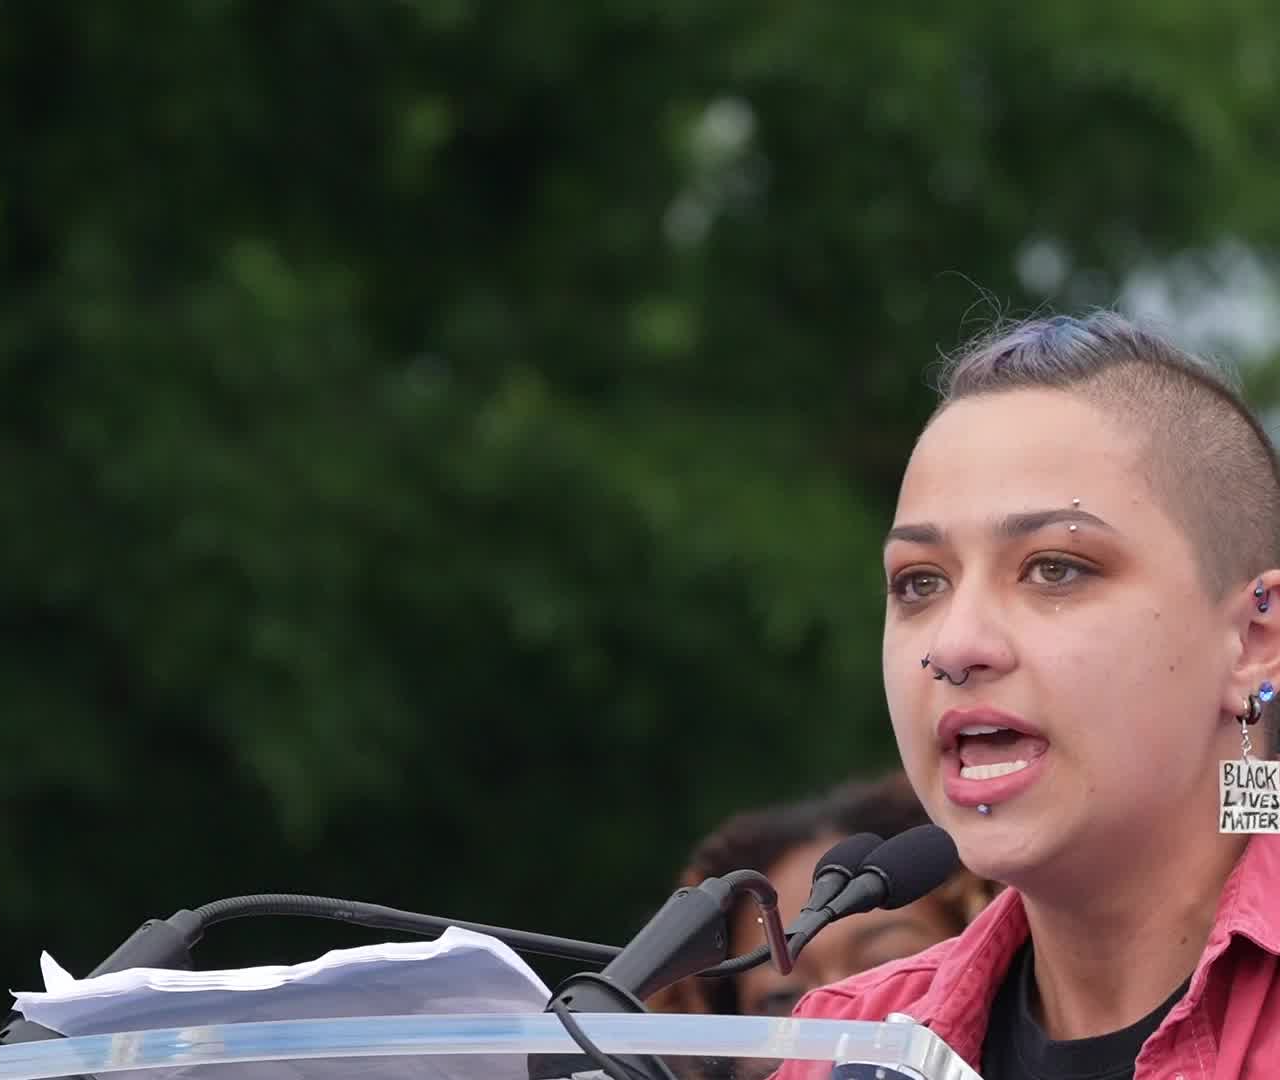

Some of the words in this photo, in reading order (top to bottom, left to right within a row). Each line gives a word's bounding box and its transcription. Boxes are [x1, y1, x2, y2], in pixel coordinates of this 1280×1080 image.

[1223, 762, 1277, 791] BLACK
[1223, 790, 1280, 810] LIVES
[1221, 811, 1278, 831] MATTER
